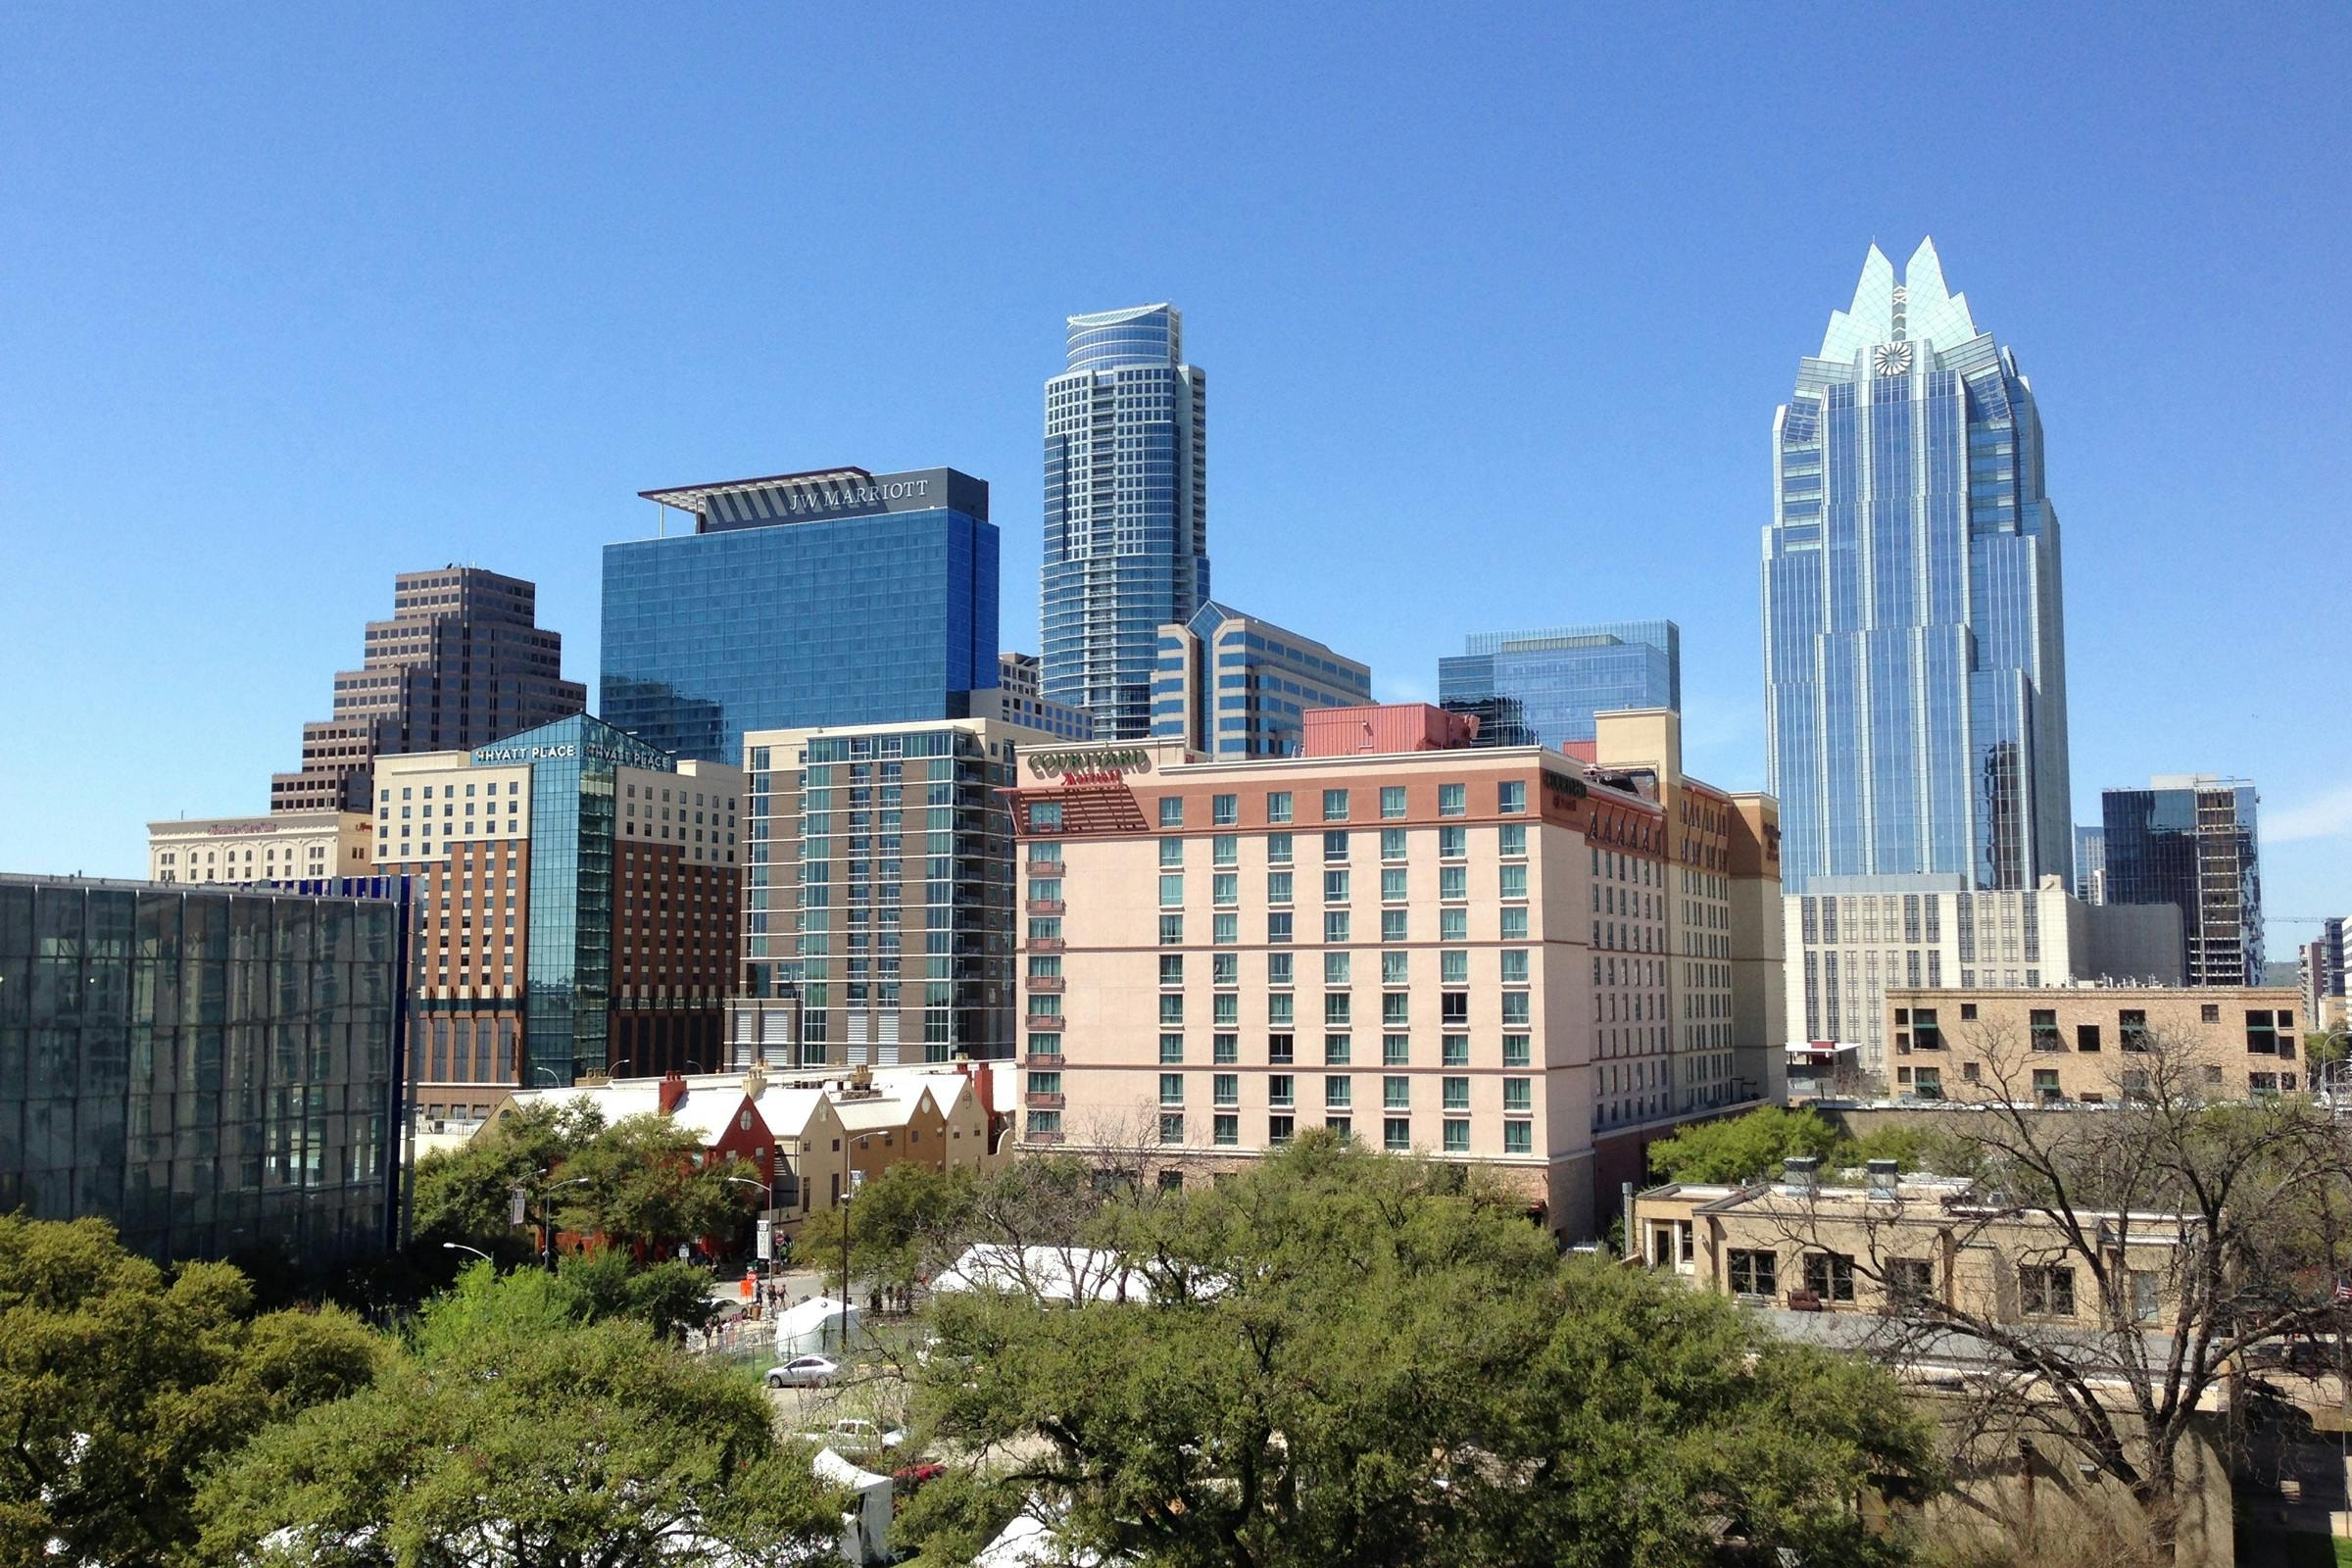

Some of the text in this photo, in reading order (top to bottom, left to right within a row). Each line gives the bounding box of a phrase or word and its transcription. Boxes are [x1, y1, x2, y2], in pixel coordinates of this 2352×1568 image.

[789, 479, 929, 511] JW MARRIOTT
[485, 745, 574, 761] HYATT PLACE
[1027, 748, 1148, 769] COURTYARD
